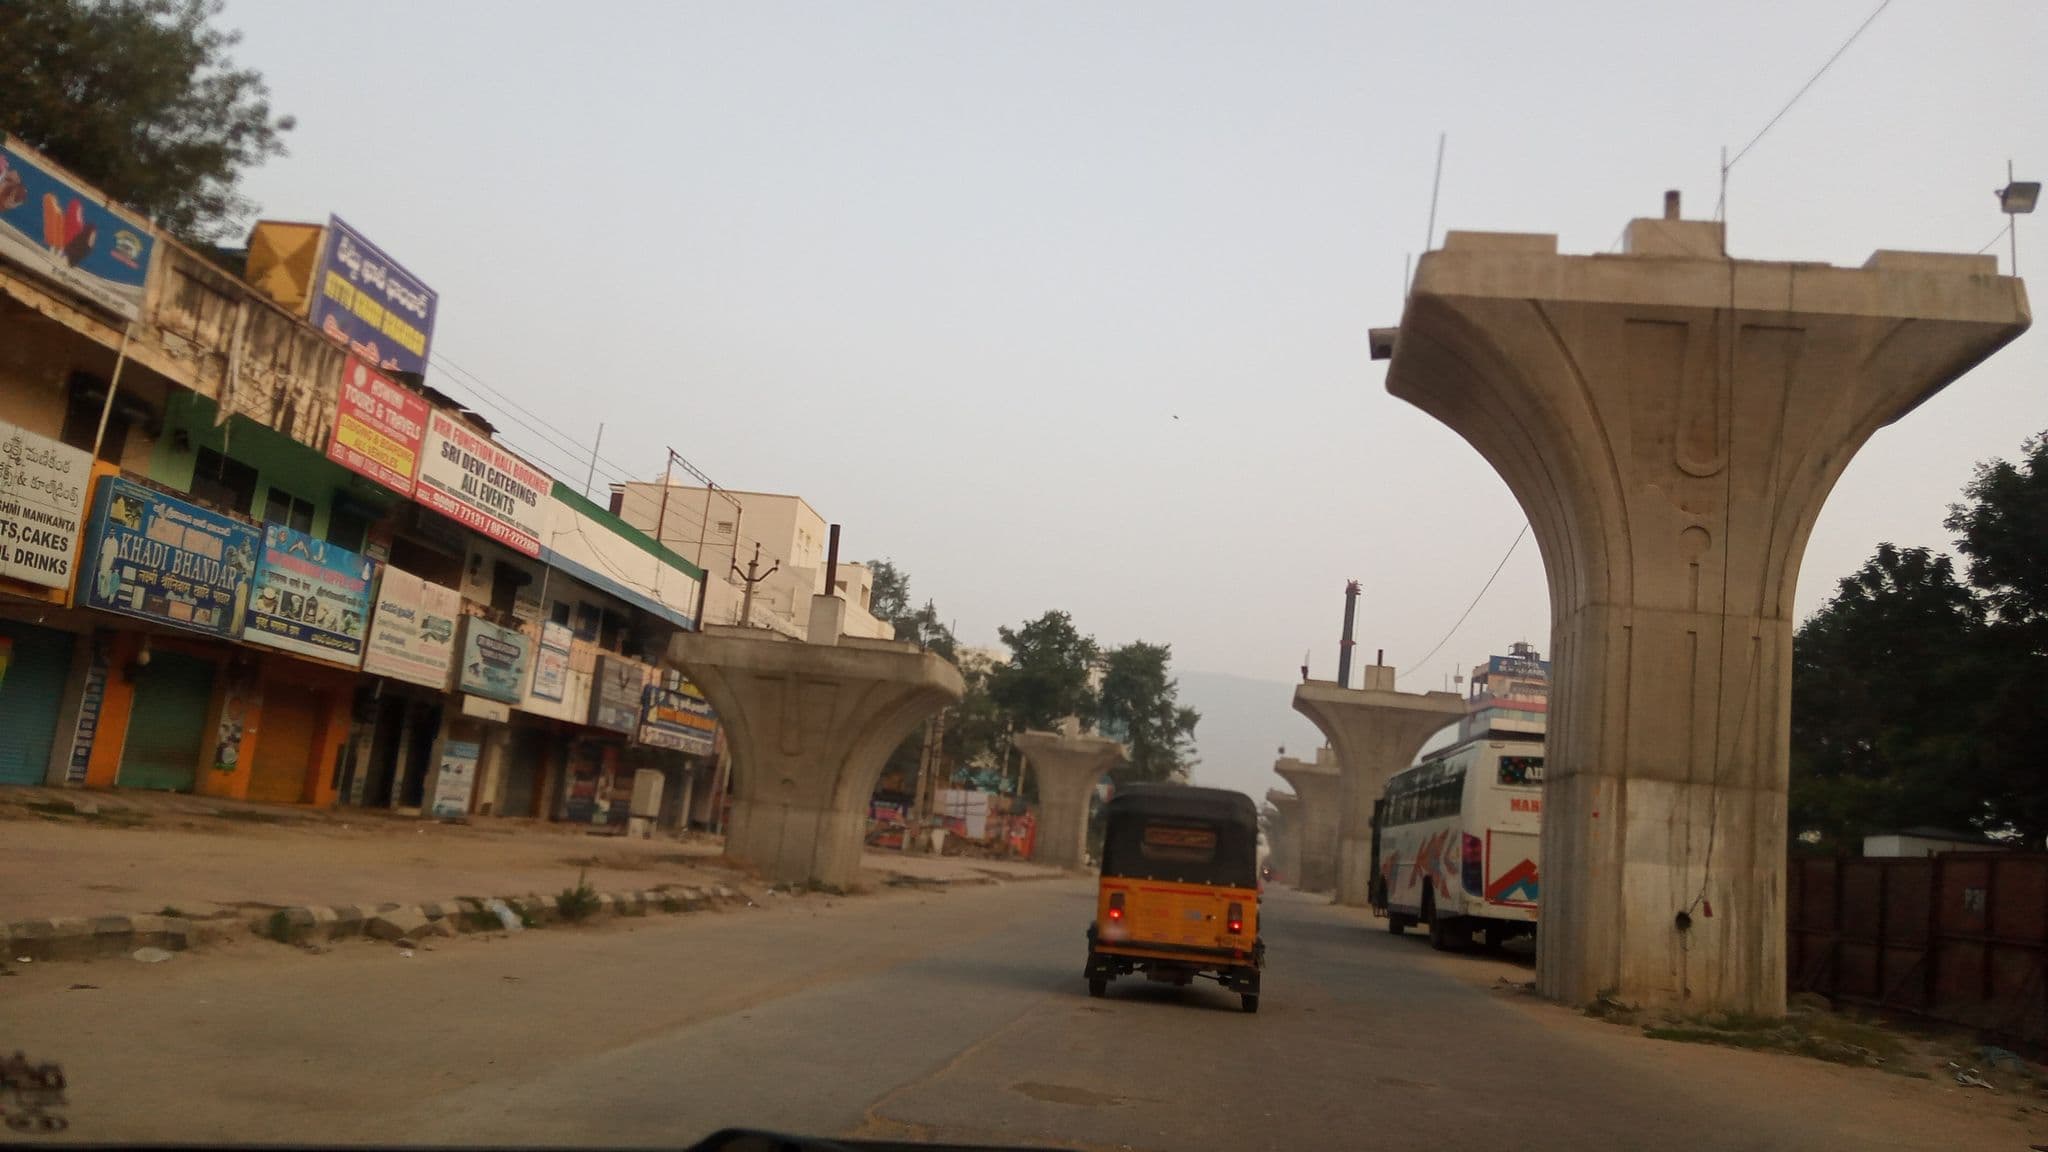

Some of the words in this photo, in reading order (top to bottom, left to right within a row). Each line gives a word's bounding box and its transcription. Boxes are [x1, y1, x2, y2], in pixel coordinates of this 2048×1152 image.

[345, 383, 376, 414] TOURS
[385, 408, 421, 440] TRAVELS
[17, 471, 27, 487] &
[441, 441, 461, 465] SRI
[462, 452, 486, 479] DEVI
[487, 467, 538, 507] CATERINGS
[453, 427, 494, 461] FUNCTION
[494, 450, 512, 475] HALL
[513, 462, 549, 496] BOOKINGS
[462, 473, 478, 498] ALL
[480, 482, 515, 516] EVENTS
[23, 507, 76, 533] MANIKANTA
[0, 545, 10, 561] L
[14, 548, 68, 576] DRINKS
[119, 532, 170, 571] KHADI
[172, 550, 238, 590] BHANDAR
